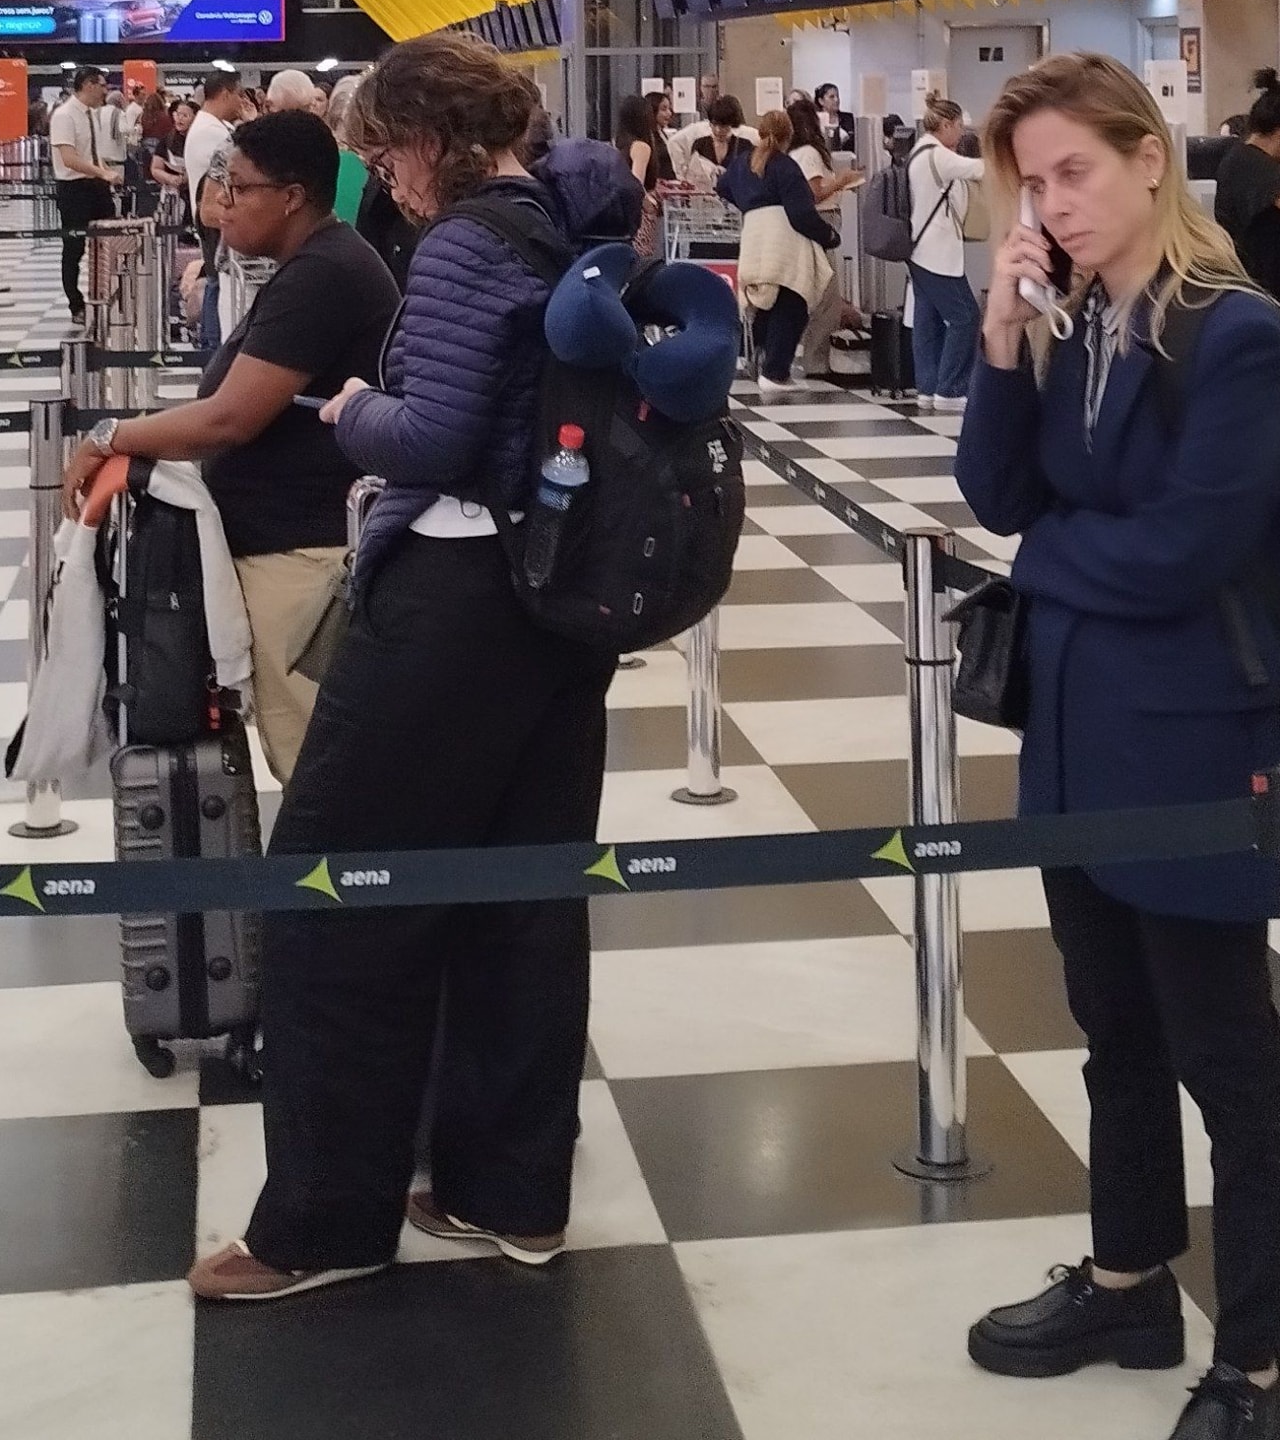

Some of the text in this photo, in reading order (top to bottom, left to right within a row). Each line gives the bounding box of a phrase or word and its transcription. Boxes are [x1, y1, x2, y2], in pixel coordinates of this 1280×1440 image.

[913, 838, 962, 858] aena
[627, 855, 676, 875] aena
[43, 878, 95, 897] aena
[340, 868, 390, 888] aena
